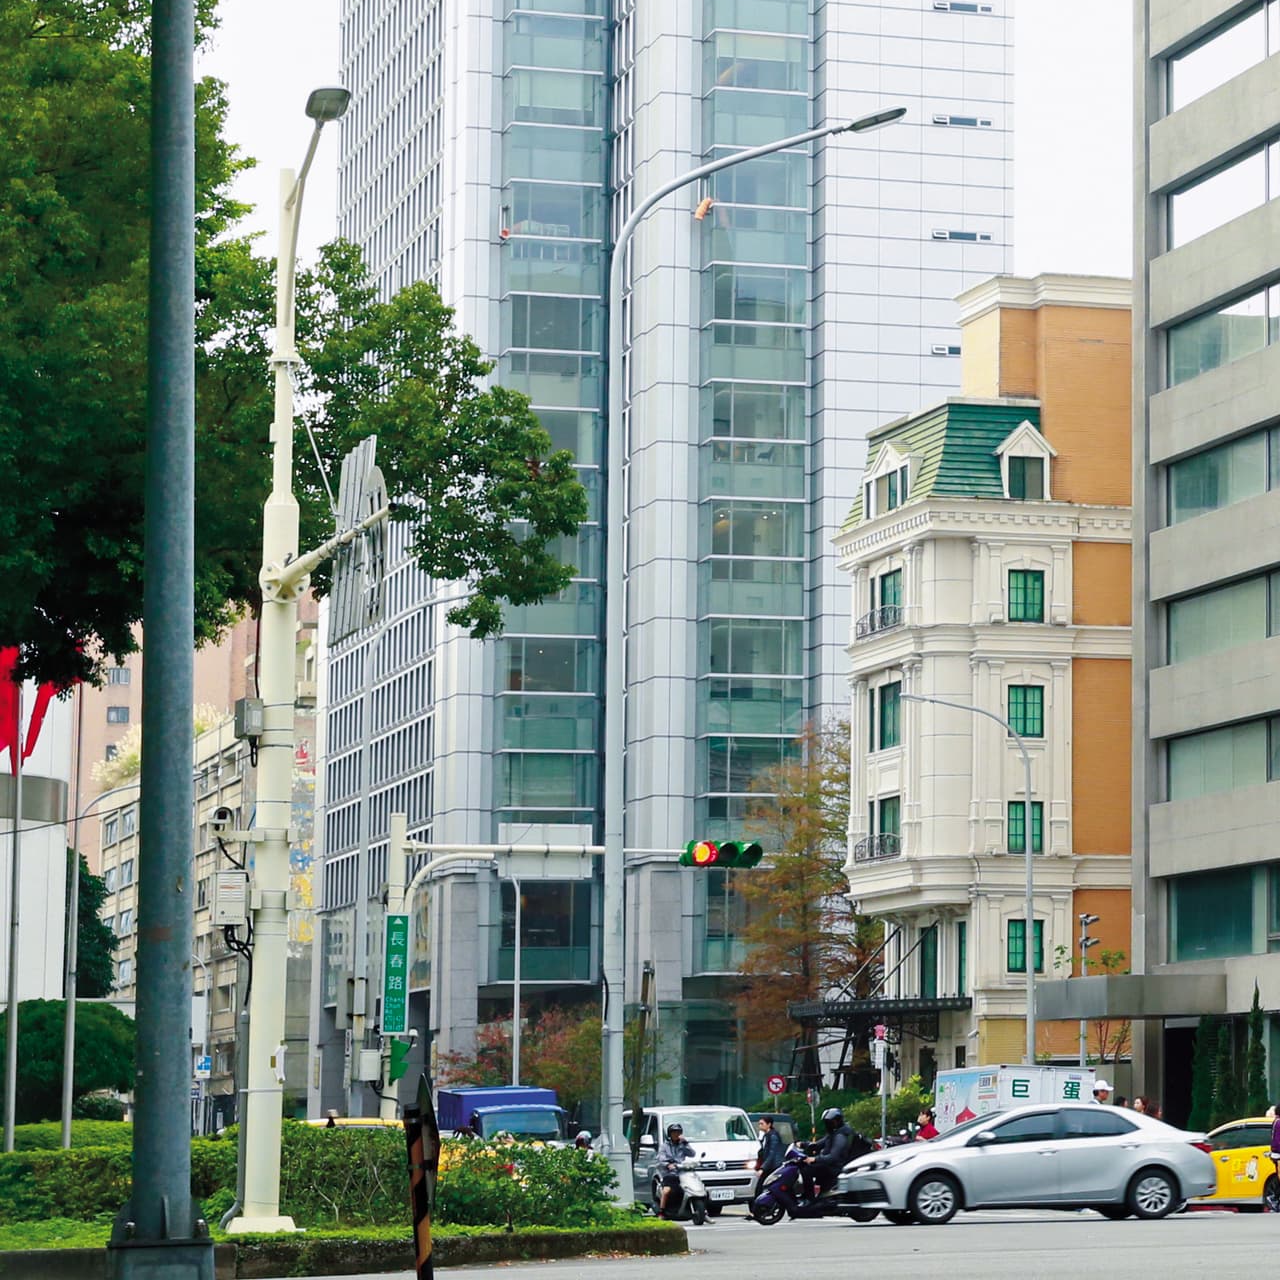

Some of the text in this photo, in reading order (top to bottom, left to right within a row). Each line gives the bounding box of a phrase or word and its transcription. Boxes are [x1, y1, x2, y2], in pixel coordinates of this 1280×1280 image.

[389, 931, 405, 990] 長春路
[1012, 1079, 1081, 1100] 巨蛋
